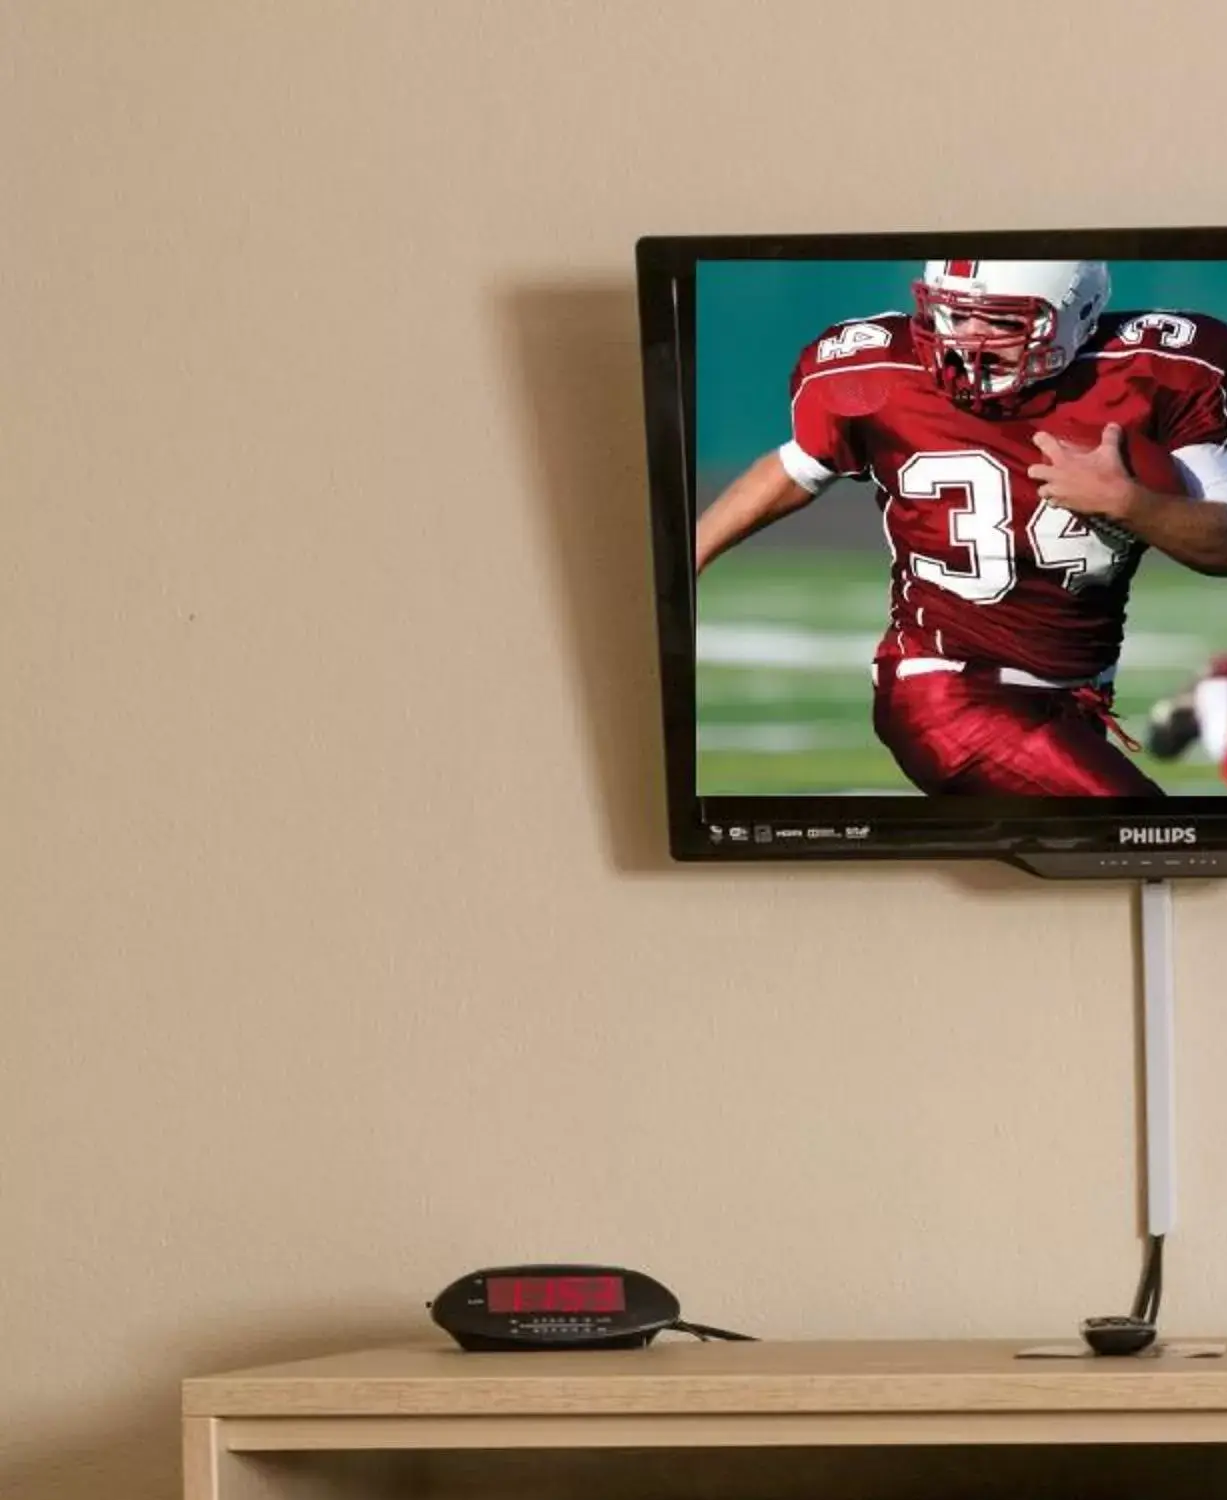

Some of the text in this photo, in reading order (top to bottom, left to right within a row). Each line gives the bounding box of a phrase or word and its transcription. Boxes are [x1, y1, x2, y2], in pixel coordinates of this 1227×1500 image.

[817, 323, 892, 363] 4
[897, 449, 1130, 606] 34
[1119, 827, 1197, 844] PHILIPS
